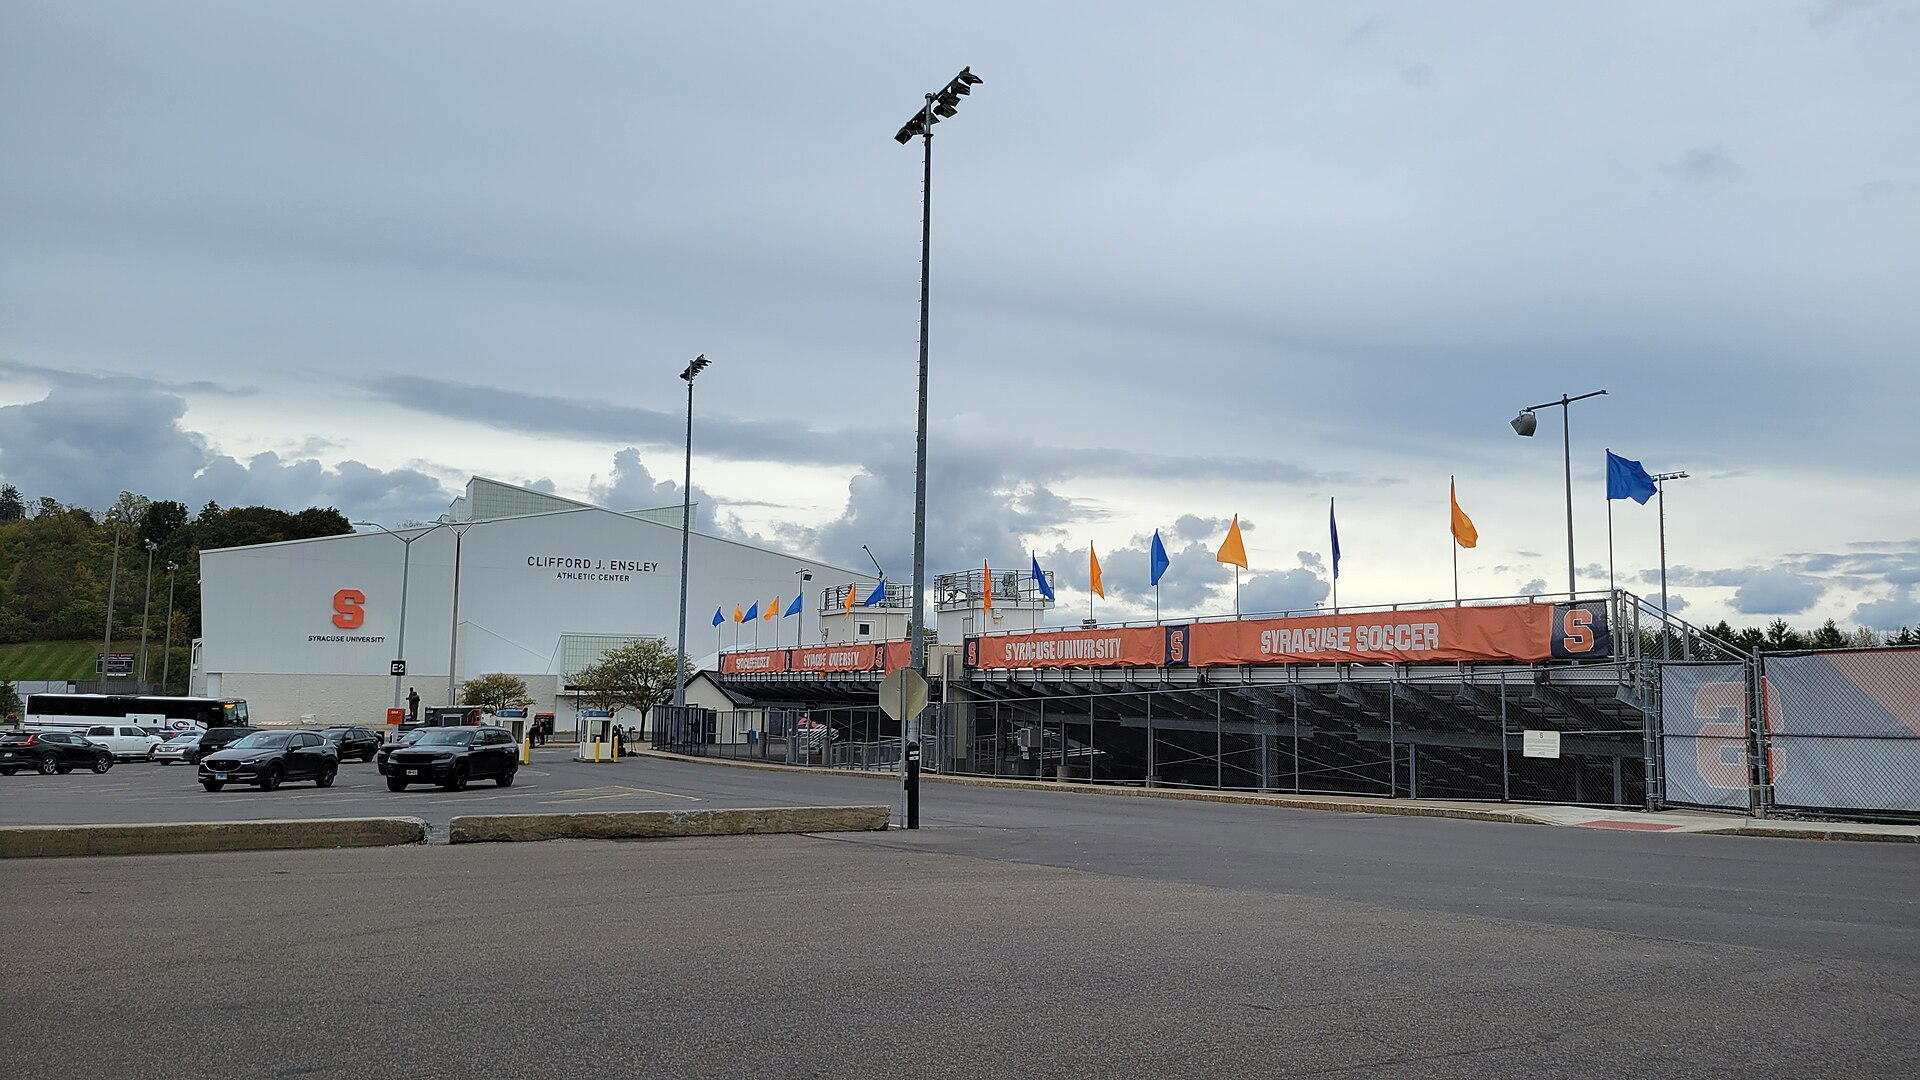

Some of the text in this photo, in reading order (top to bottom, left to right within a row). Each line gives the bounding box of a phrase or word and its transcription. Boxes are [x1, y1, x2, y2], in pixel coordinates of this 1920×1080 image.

[527, 556, 658, 572] CLIFFORD J. ENSLEY
[556, 572, 630, 582] ATHLETIC CENTER
[332, 589, 365, 629] S
[346, 635, 385, 643] UNIVERSITY
[1261, 623, 1439, 654] SYRACUSE SOCCER
[1564, 608, 1595, 653] S
[967, 641, 977, 666] S
[1005, 638, 1121, 661] SYRACUSE UNIVERSITY
[1170, 630, 1184, 662] S
[392, 663, 404, 673] E2
[803, 653, 827, 667] SYACSE
[829, 652, 859, 667] UERSITY
